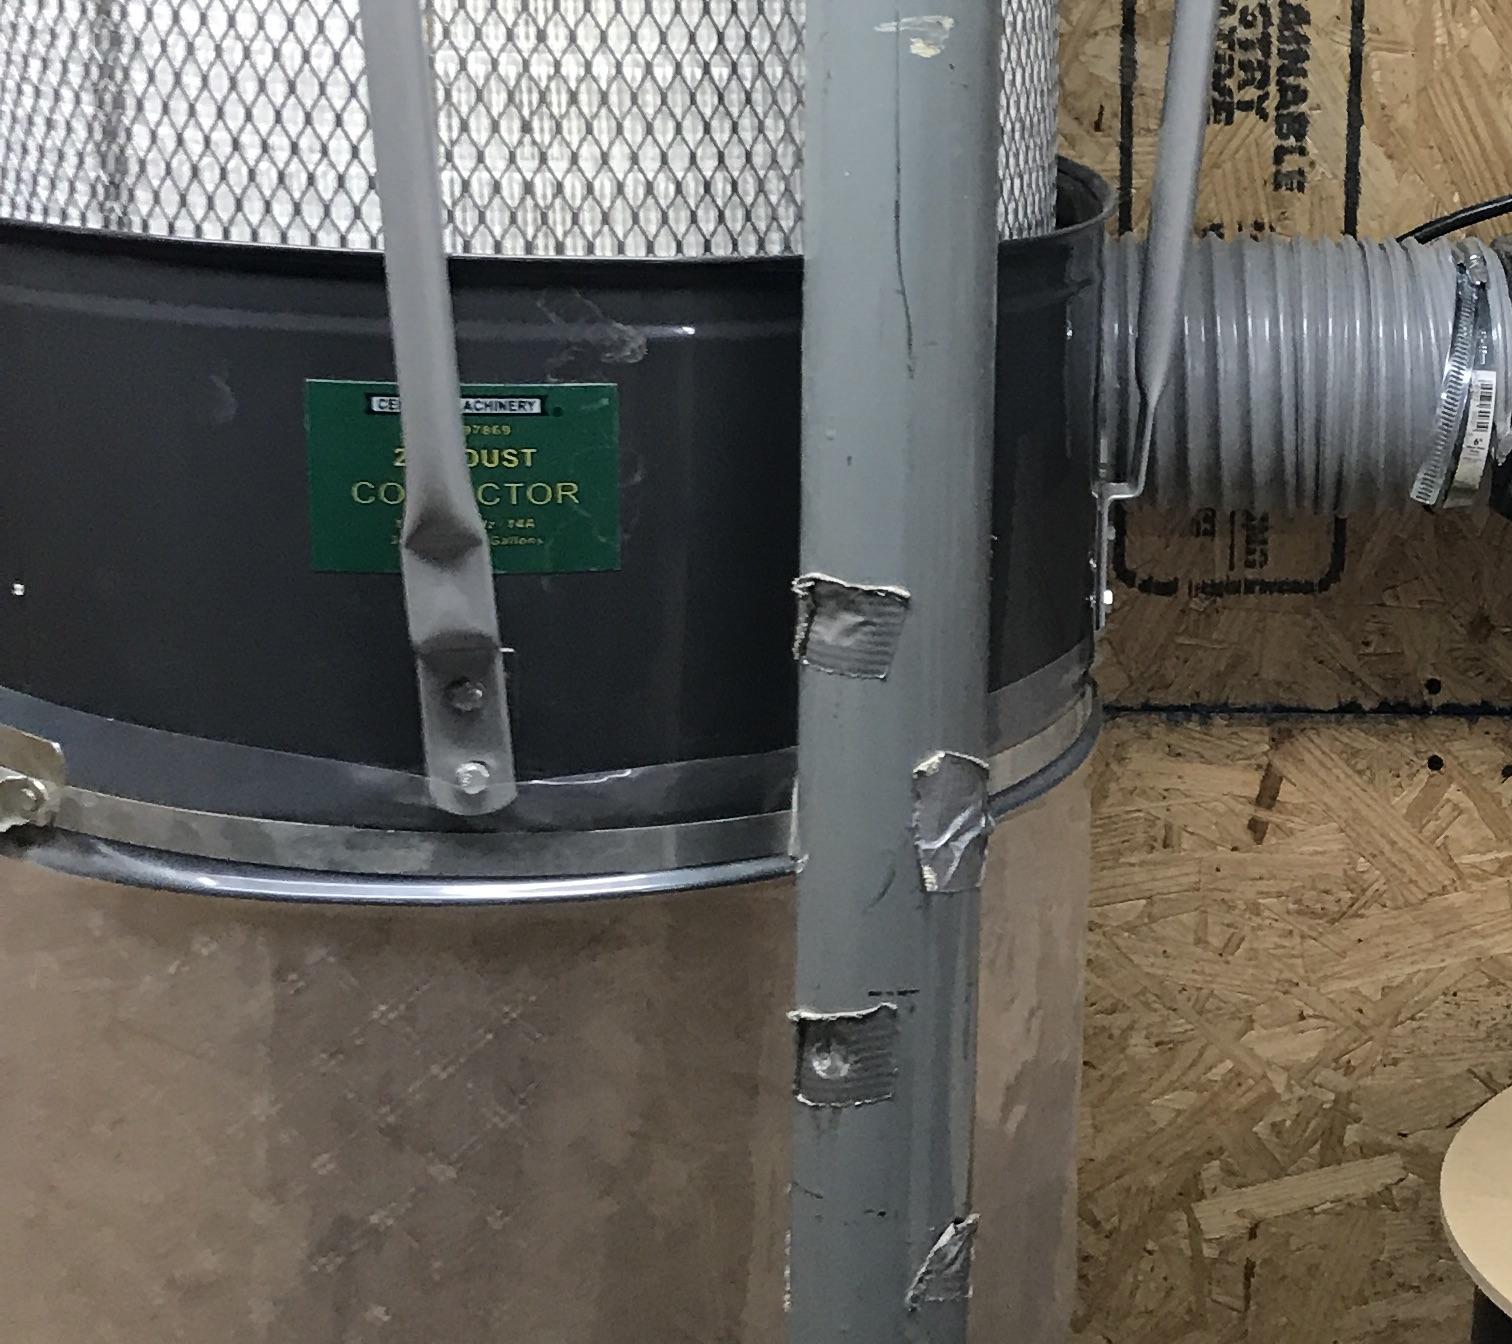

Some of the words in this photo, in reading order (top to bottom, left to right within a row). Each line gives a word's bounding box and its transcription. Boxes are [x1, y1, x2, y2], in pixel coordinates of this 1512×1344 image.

[463, 399, 537, 413] ACHINERY
[463, 447, 537, 468] DUST
[351, 482, 580, 506] COCTOR
